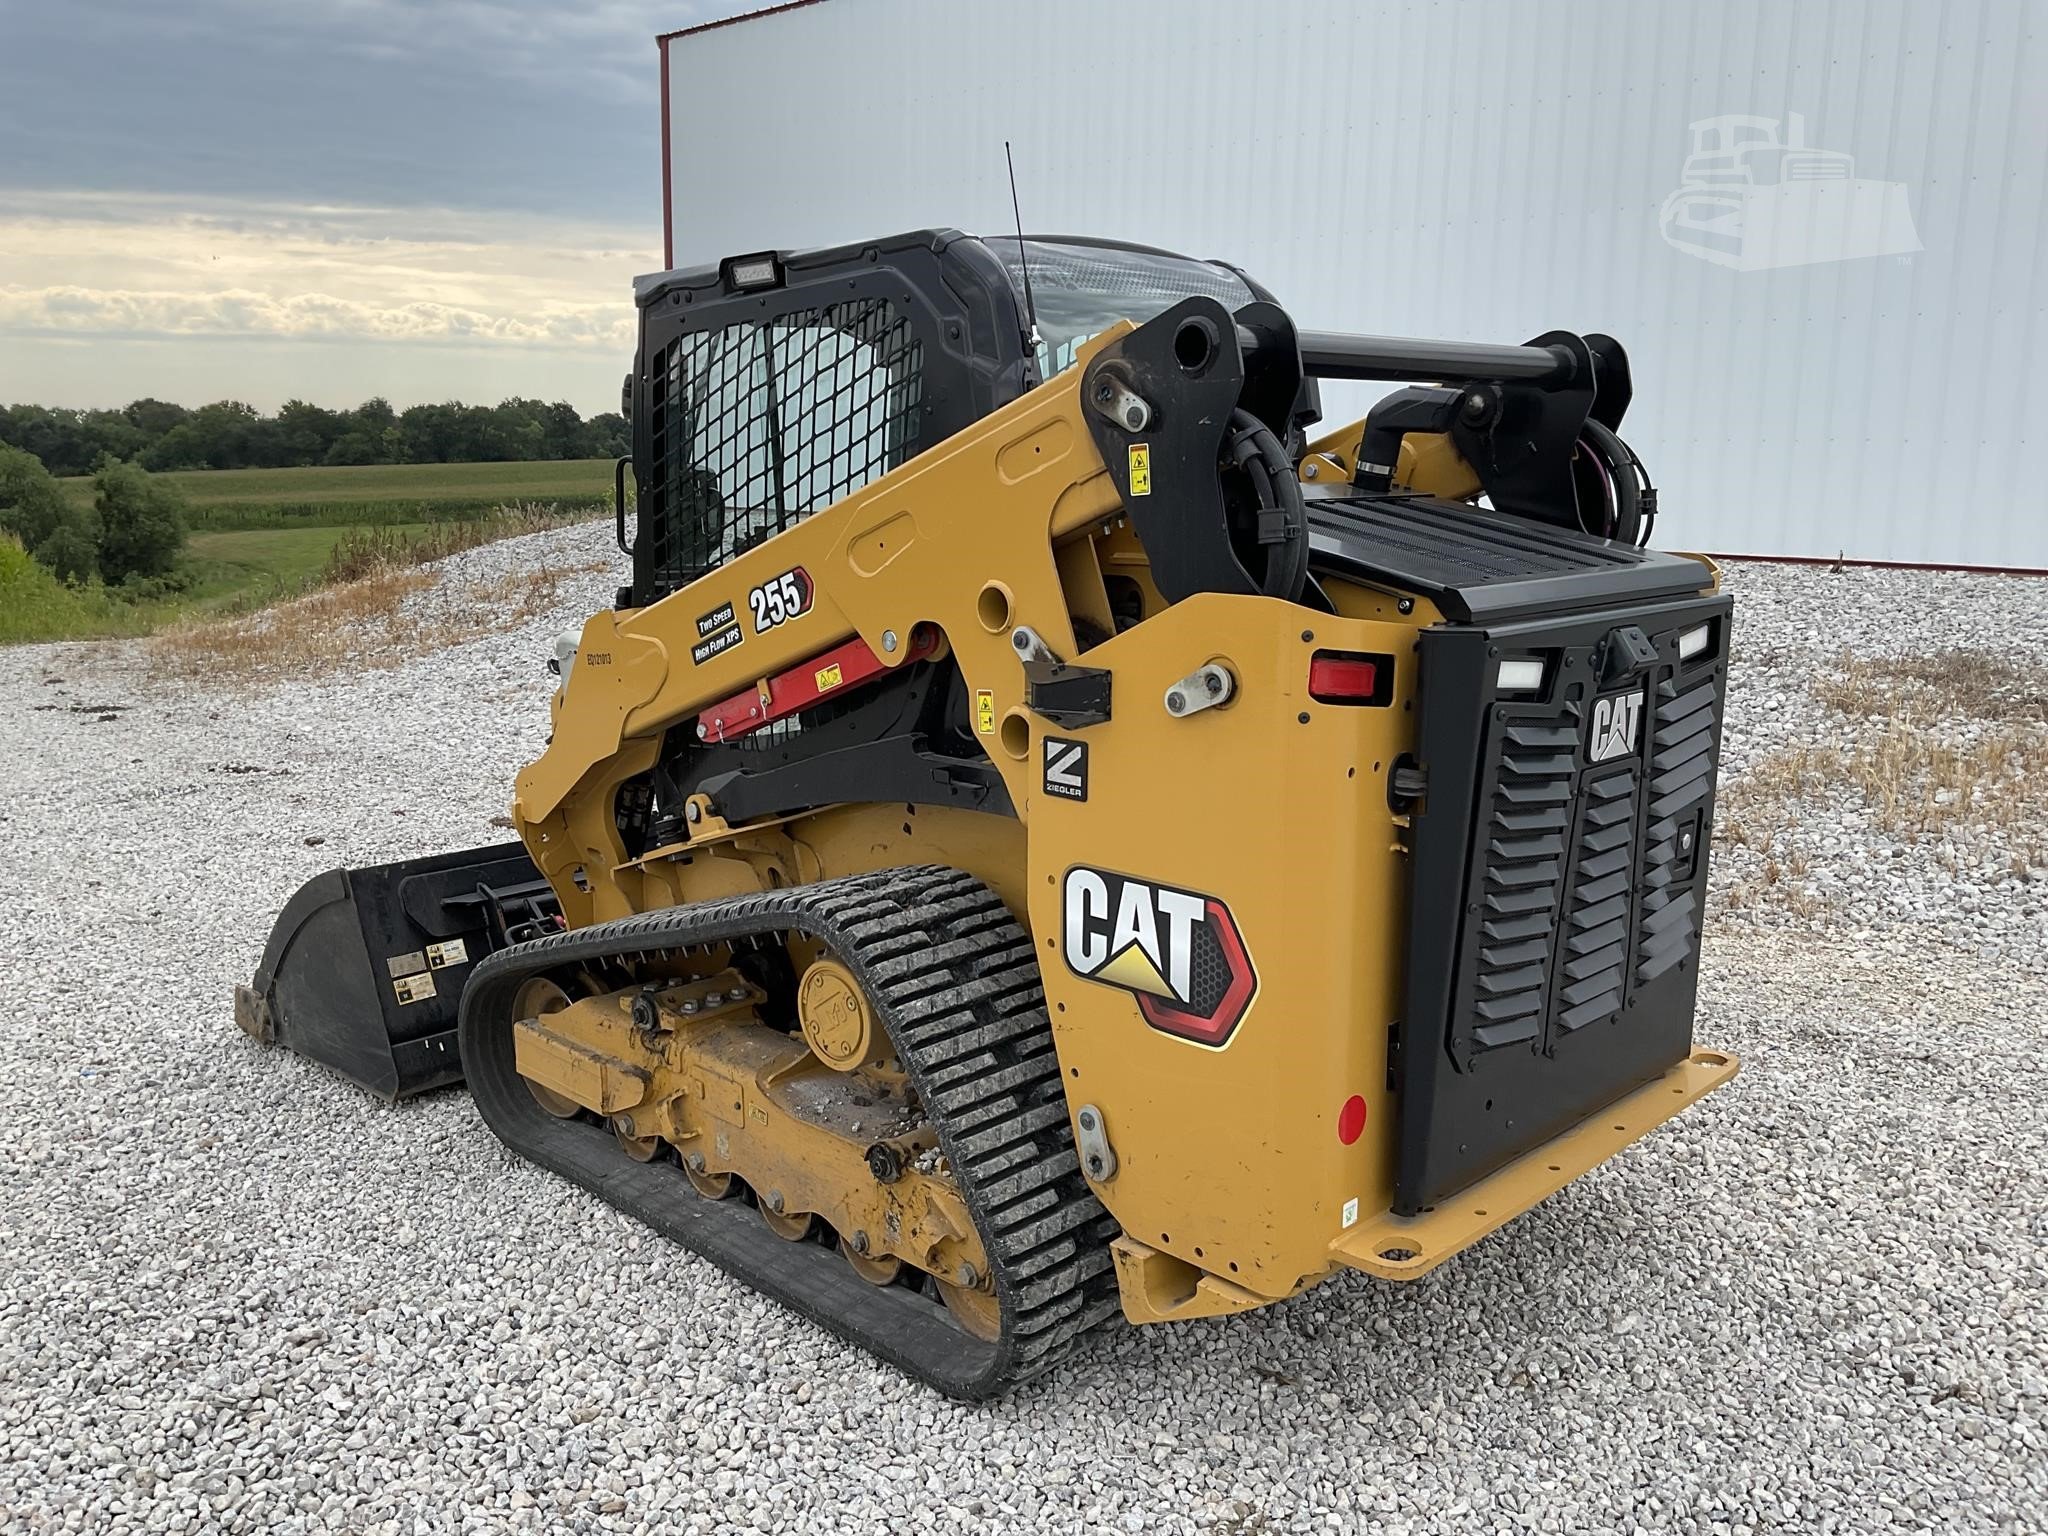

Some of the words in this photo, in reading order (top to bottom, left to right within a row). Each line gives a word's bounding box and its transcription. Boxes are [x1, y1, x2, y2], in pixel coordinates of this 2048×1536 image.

[750, 572, 801, 631] 255
[726, 628, 739, 645] XPS
[1590, 692, 1644, 762] CAT
[1047, 783, 1082, 797] ZIEGLER
[1066, 869, 1205, 1004] CAT
